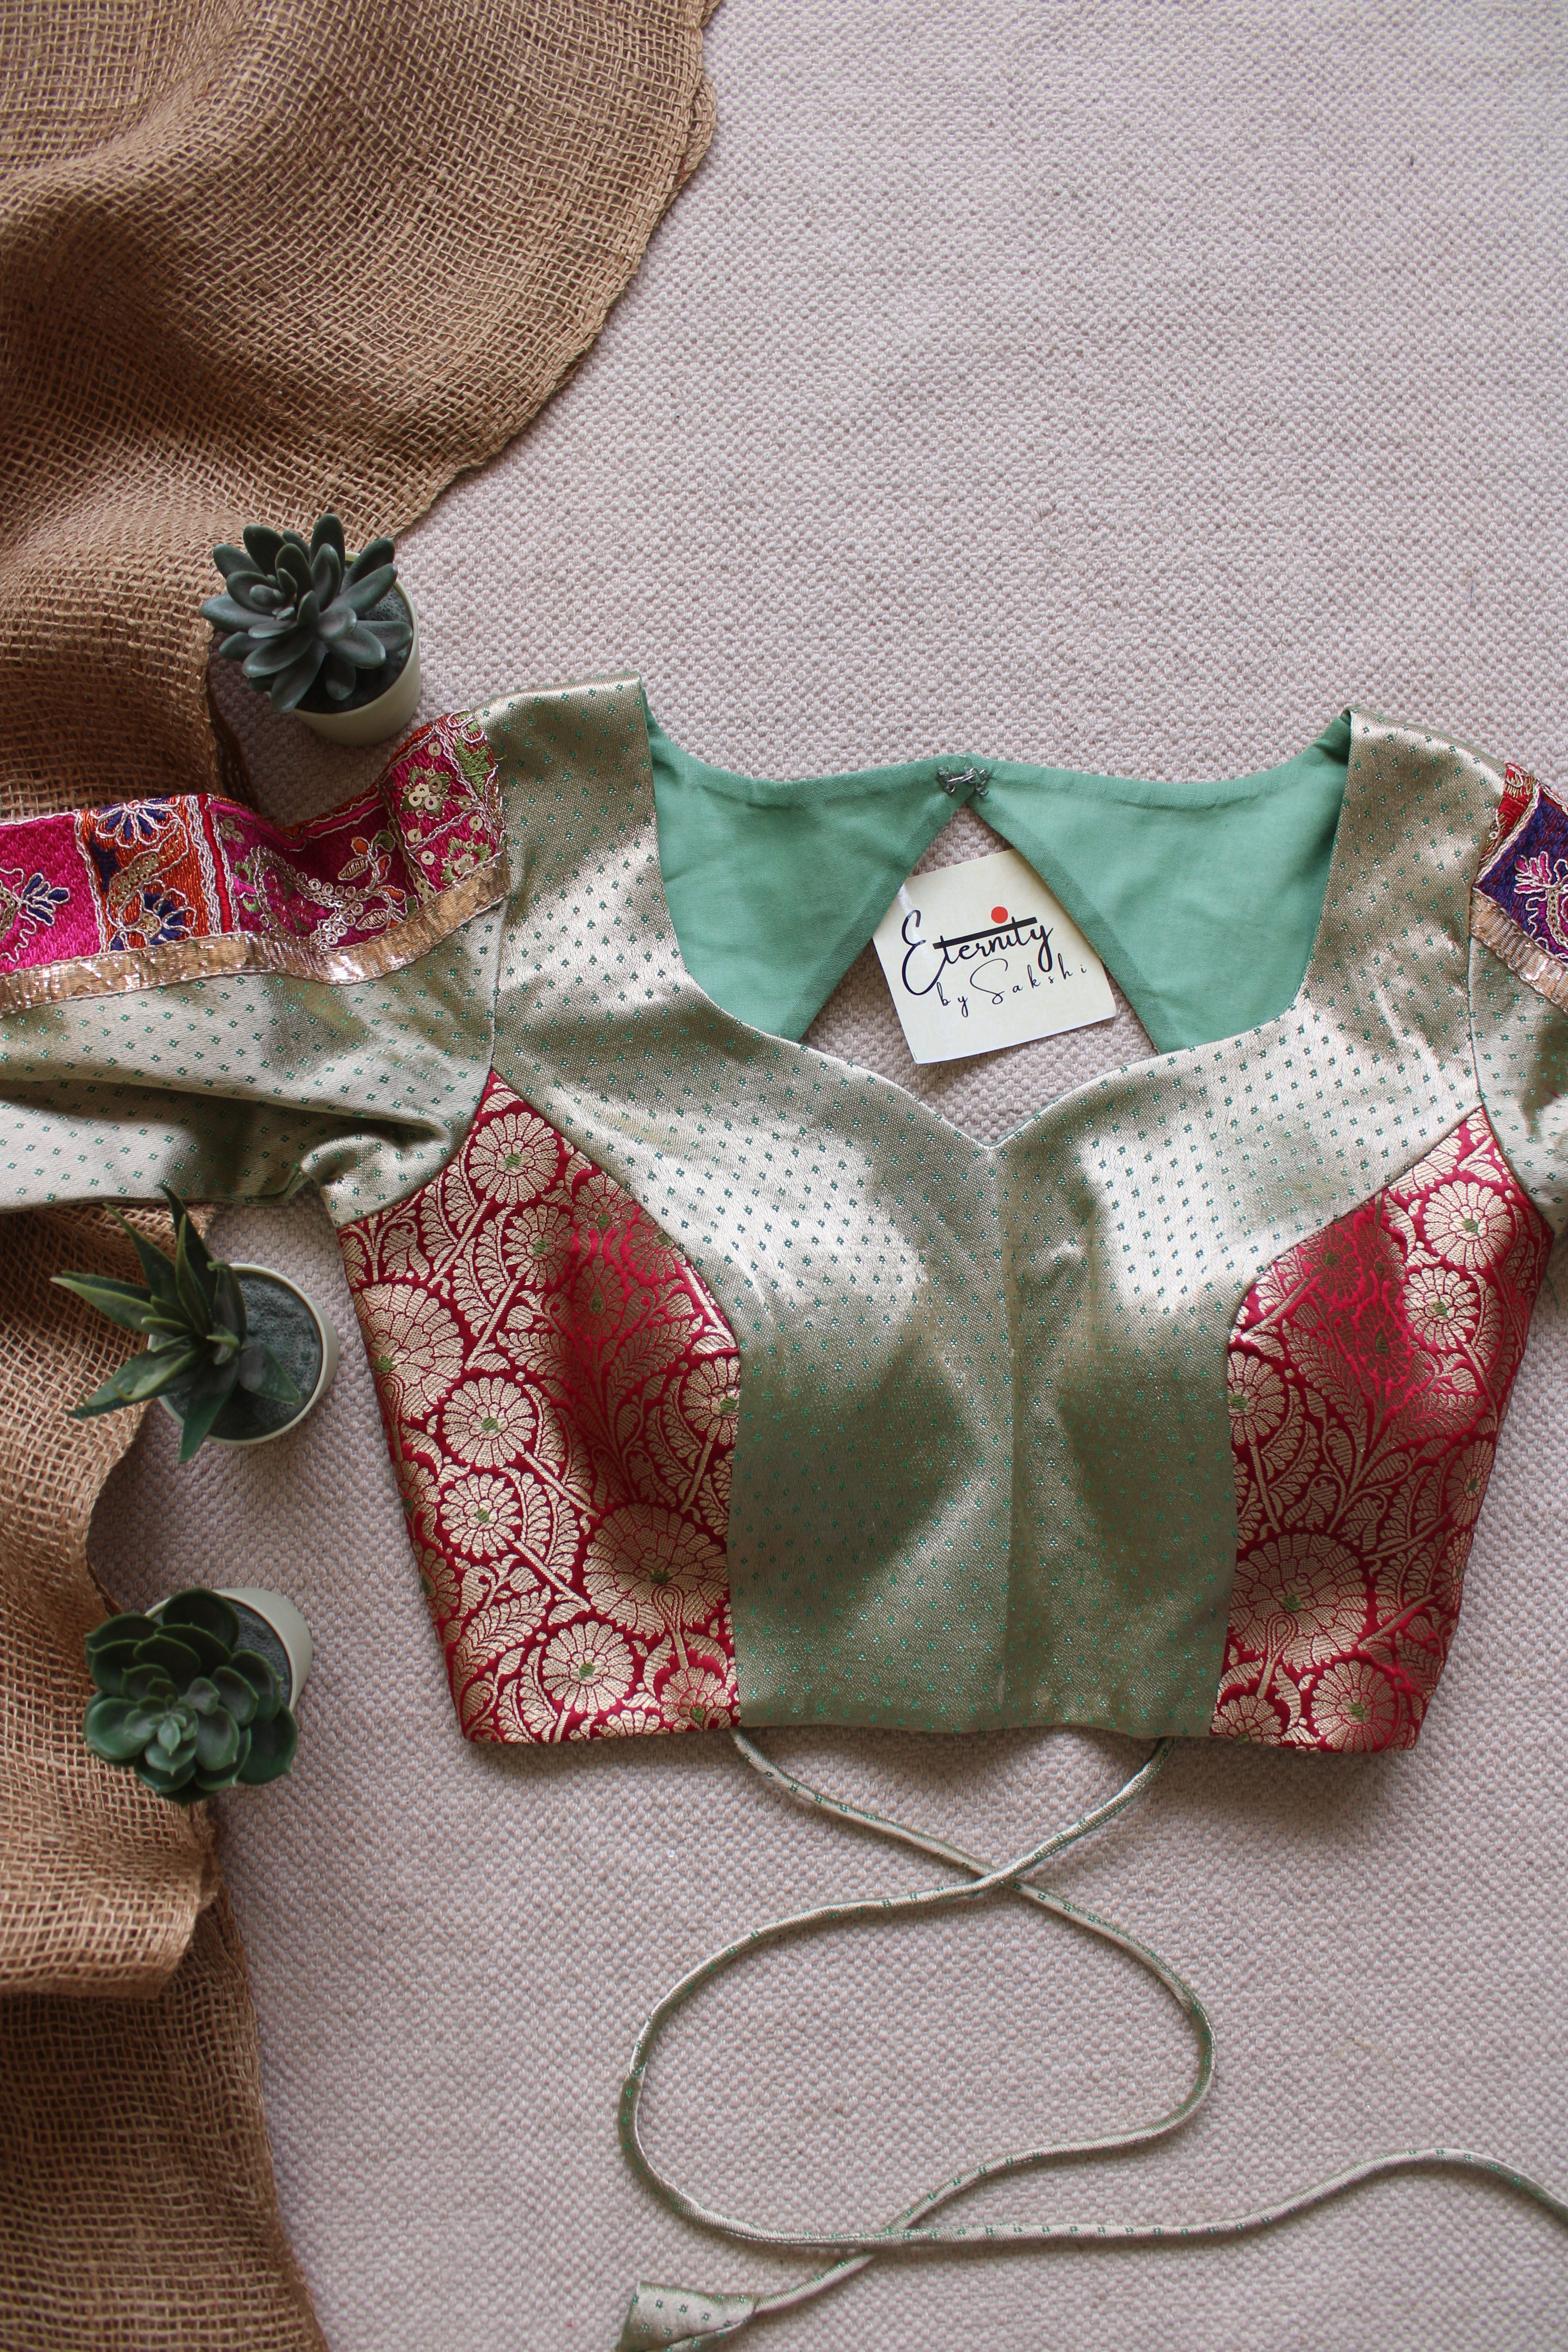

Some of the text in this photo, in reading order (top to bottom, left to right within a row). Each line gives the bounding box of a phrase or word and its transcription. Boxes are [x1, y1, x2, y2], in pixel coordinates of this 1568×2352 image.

[902, 906, 1054, 996] Eternity
[937, 953, 1087, 1018] by Sakshi
